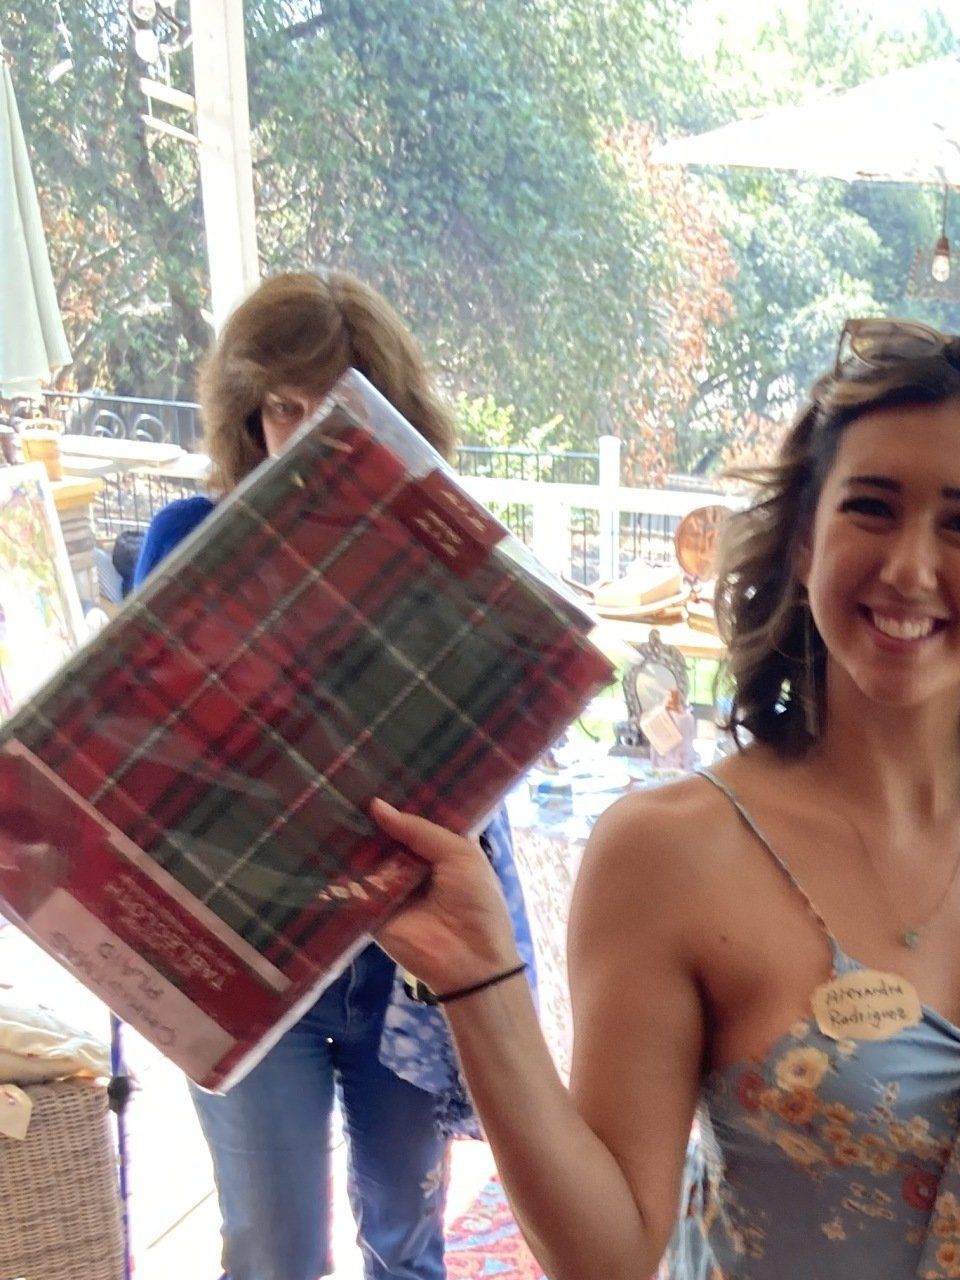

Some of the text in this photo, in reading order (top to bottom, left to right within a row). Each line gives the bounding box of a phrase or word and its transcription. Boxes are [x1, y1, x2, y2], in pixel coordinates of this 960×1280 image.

[50, 930, 177, 1046] CHRISTMAS
[96, 941, 165, 1000] PLAID
[826, 979, 904, 1005] Alexandra
[828, 1004, 909, 1029] Rodriguez
